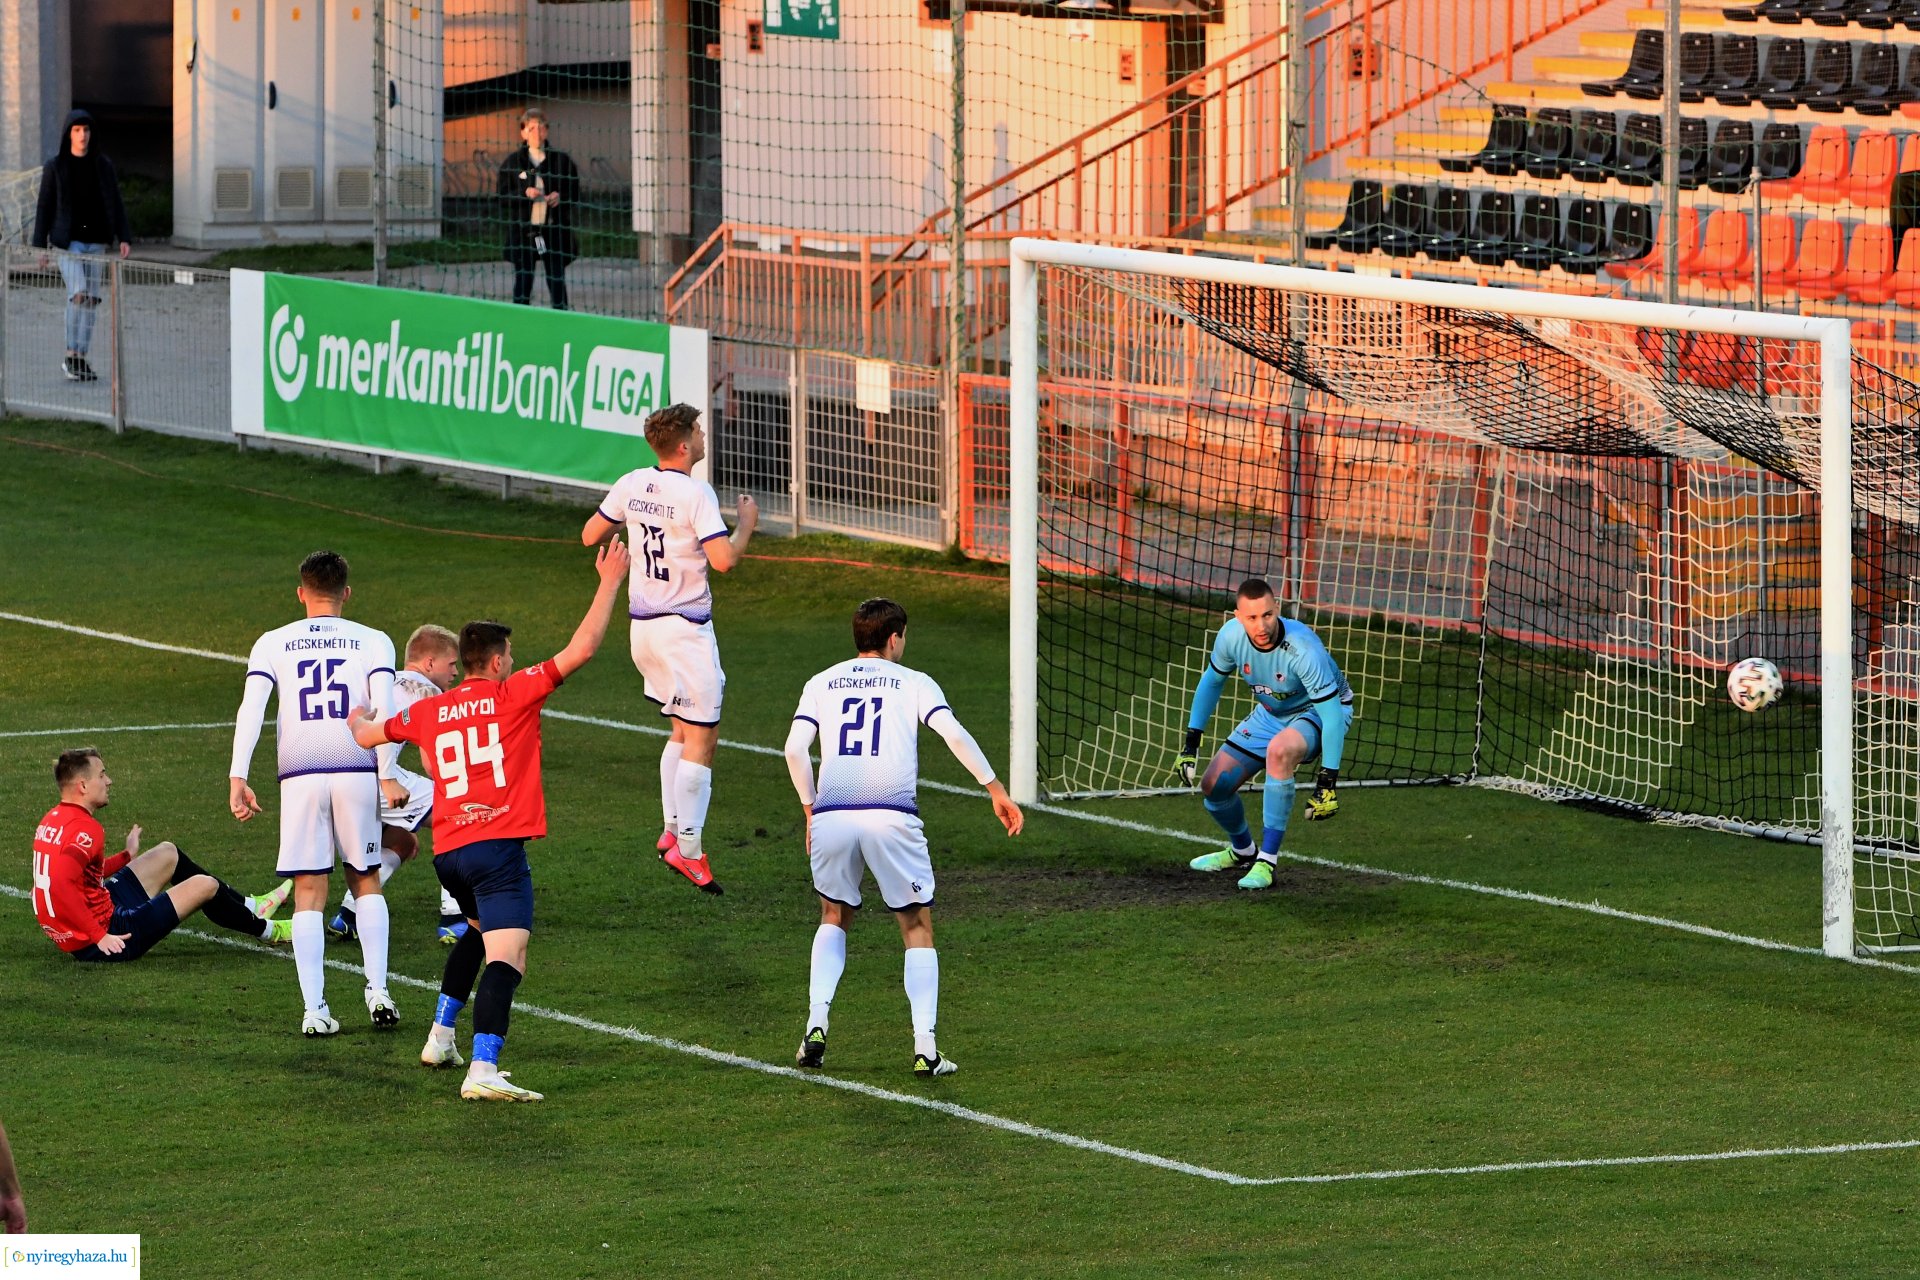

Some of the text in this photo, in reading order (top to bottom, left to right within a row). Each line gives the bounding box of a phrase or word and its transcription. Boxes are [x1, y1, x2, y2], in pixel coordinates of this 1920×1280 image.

[315, 319, 654, 425] merkantilbank LIGA
[666, 506, 675, 519] TE
[640, 522, 670, 582] 12
[285, 637, 361, 652] KECSKEMÉTI TE
[297, 658, 350, 721] 25
[437, 697, 496, 723] BANYOI
[828, 676, 901, 690] KECSKEMÉTI TE
[838, 697, 883, 756] 21
[435, 722, 507, 799] 94
